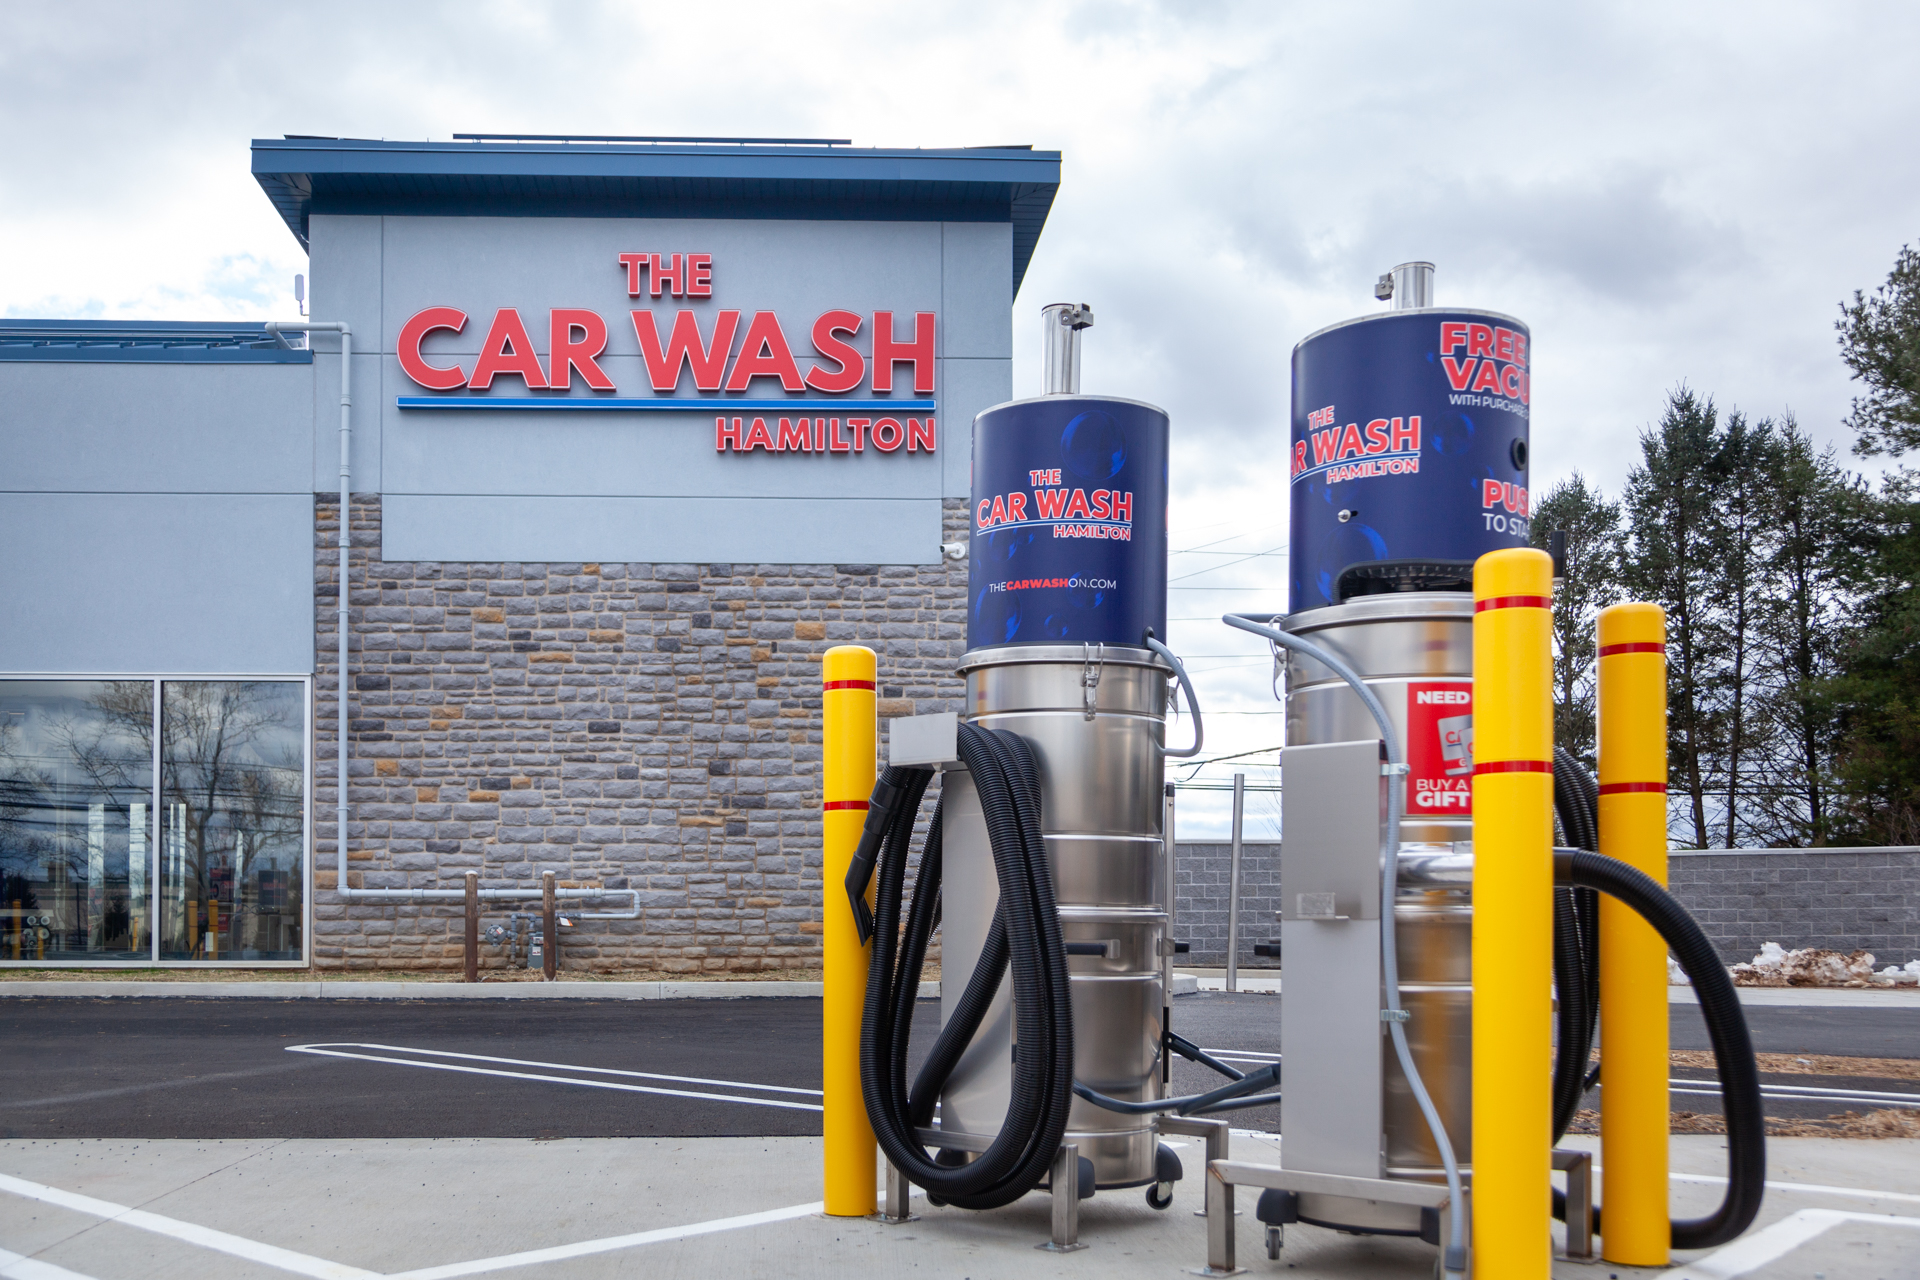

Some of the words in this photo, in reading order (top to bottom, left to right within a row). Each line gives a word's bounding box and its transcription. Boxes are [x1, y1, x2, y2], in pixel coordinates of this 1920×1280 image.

[619, 252, 713, 299] THE
[397, 305, 617, 392] CAR
[630, 309, 936, 393] WASH
[1440, 321, 1526, 369] FREE
[1449, 394, 1481, 406] WITH
[1308, 405, 1335, 431] THE
[716, 416, 936, 453] HAMILTON
[1311, 416, 1421, 466] WASH
[1029, 469, 1062, 487] THE
[1326, 458, 1419, 485] HAMILTON
[976, 491, 1027, 529] CAR
[1035, 488, 1133, 521] WASH
[1483, 478, 1529, 520] PUS
[1053, 524, 1131, 542] HAMILTON
[1482, 513, 1507, 532] TO
[989, 578, 1117, 593] THECARWASHON.COM
[1416, 690, 1470, 704] NEED
[1416, 779, 1453, 791] BUY
[1455, 779, 1468, 791] A
[1415, 790, 1470, 807] GIFT
